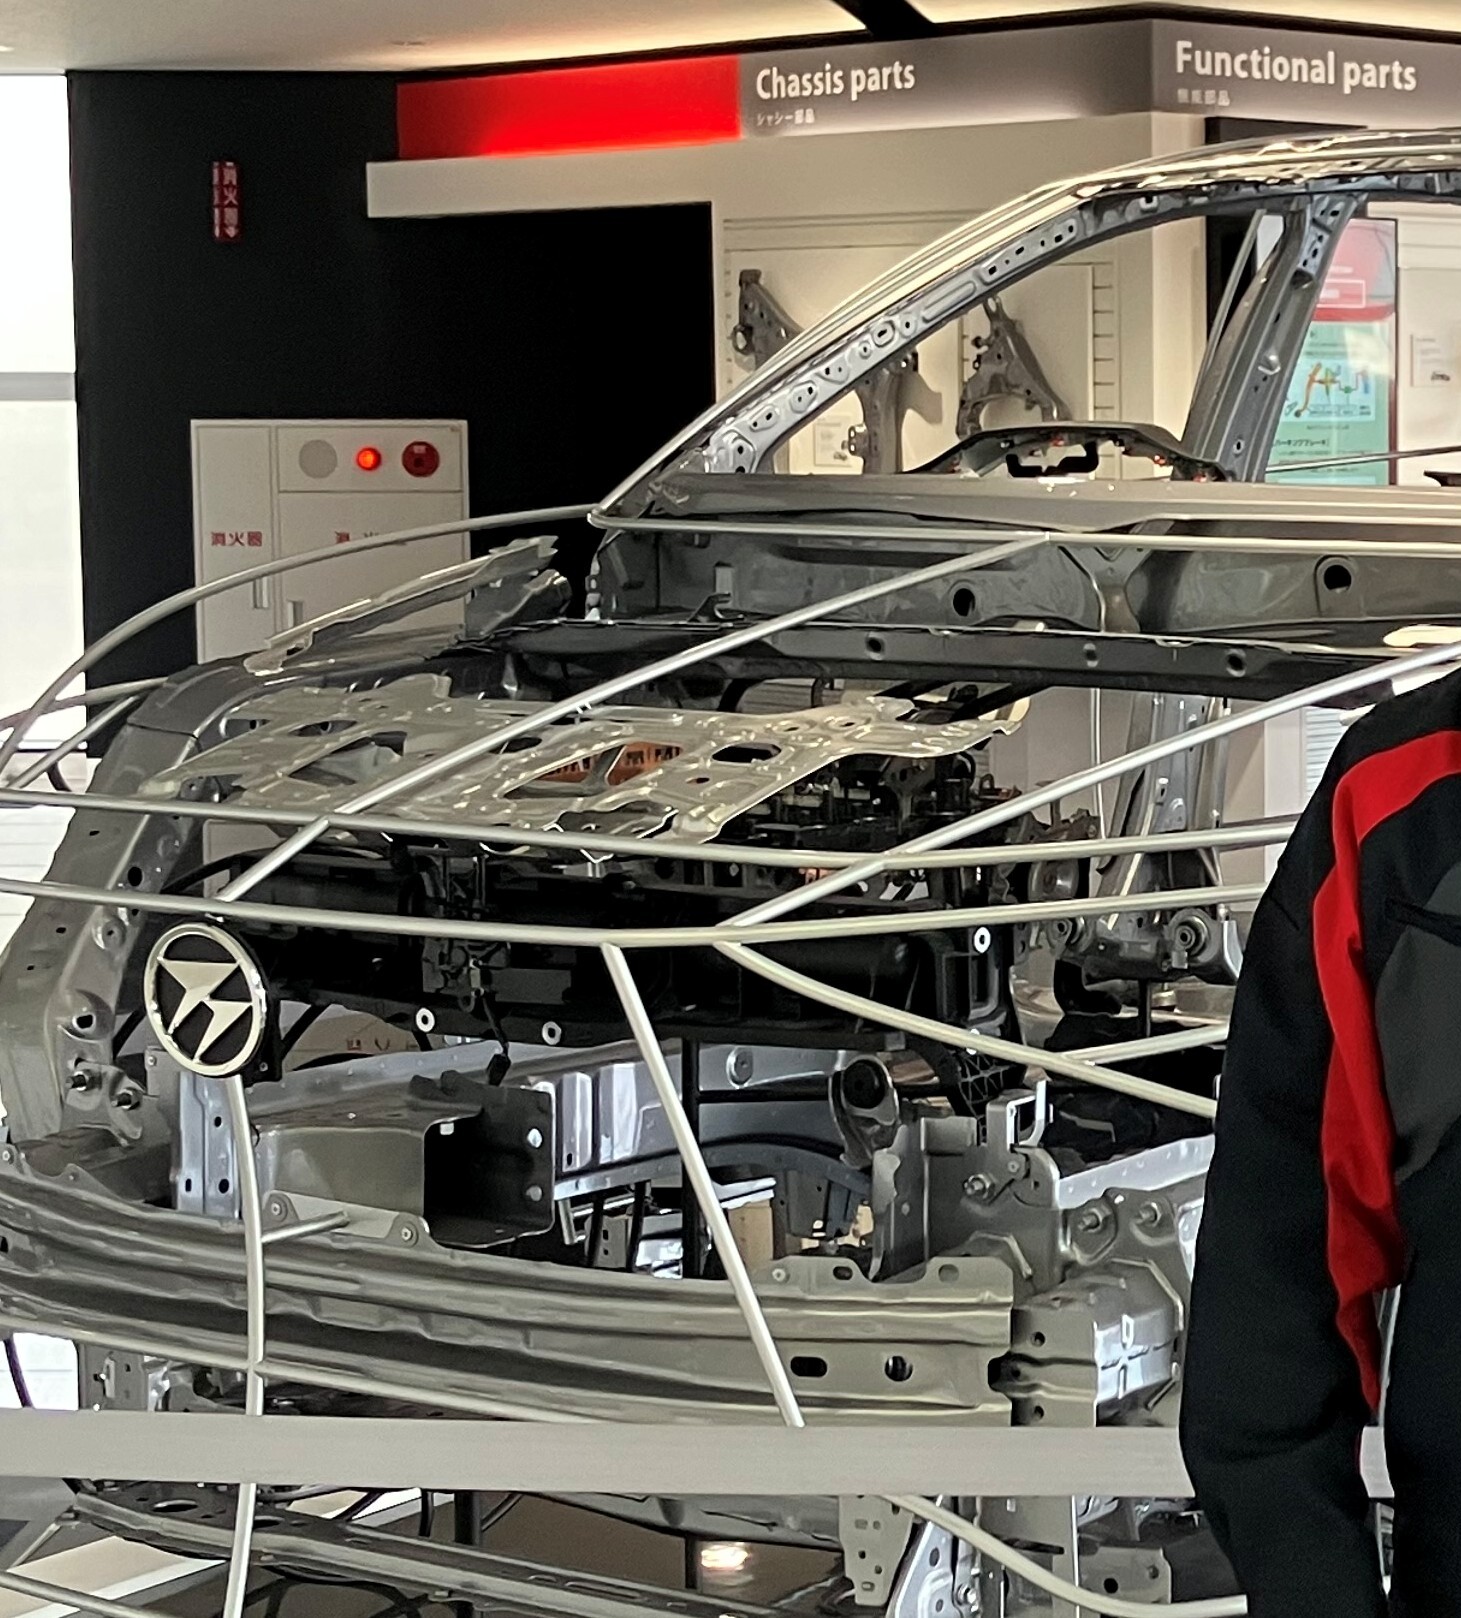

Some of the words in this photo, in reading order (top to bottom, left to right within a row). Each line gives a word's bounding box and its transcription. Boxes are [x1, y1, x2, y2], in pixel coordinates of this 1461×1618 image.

[756, 61, 845, 100] Chassis
[850, 60, 916, 101] parts
[1176, 40, 1336, 85] Functional
[1343, 60, 1418, 94] parts
